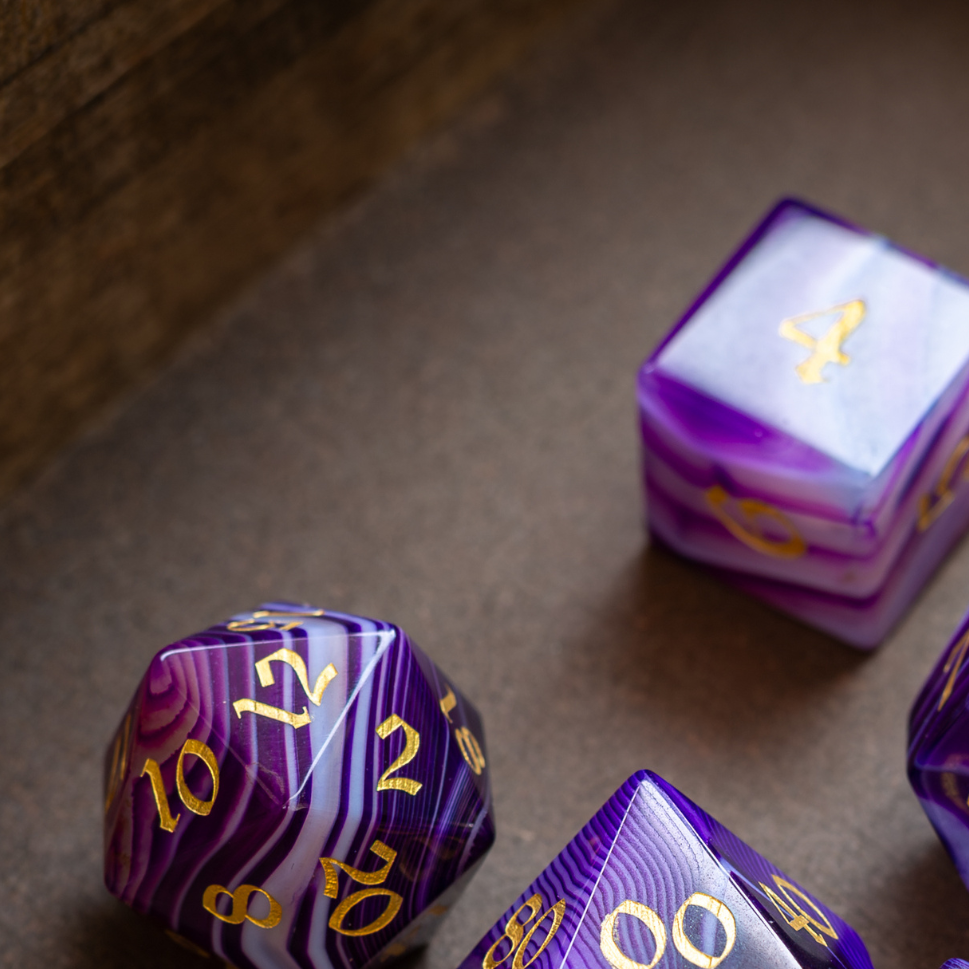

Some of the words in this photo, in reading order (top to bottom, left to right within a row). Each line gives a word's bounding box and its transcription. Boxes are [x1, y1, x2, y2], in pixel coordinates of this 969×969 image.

[779, 298, 867, 384] 4
[233, 647, 338, 730] 12
[140, 738, 220, 834] 10
[376, 713, 423, 796] 2
[202, 884, 283, 929] 8
[319, 839, 404, 937] 20
[758, 873, 839, 948] 40
